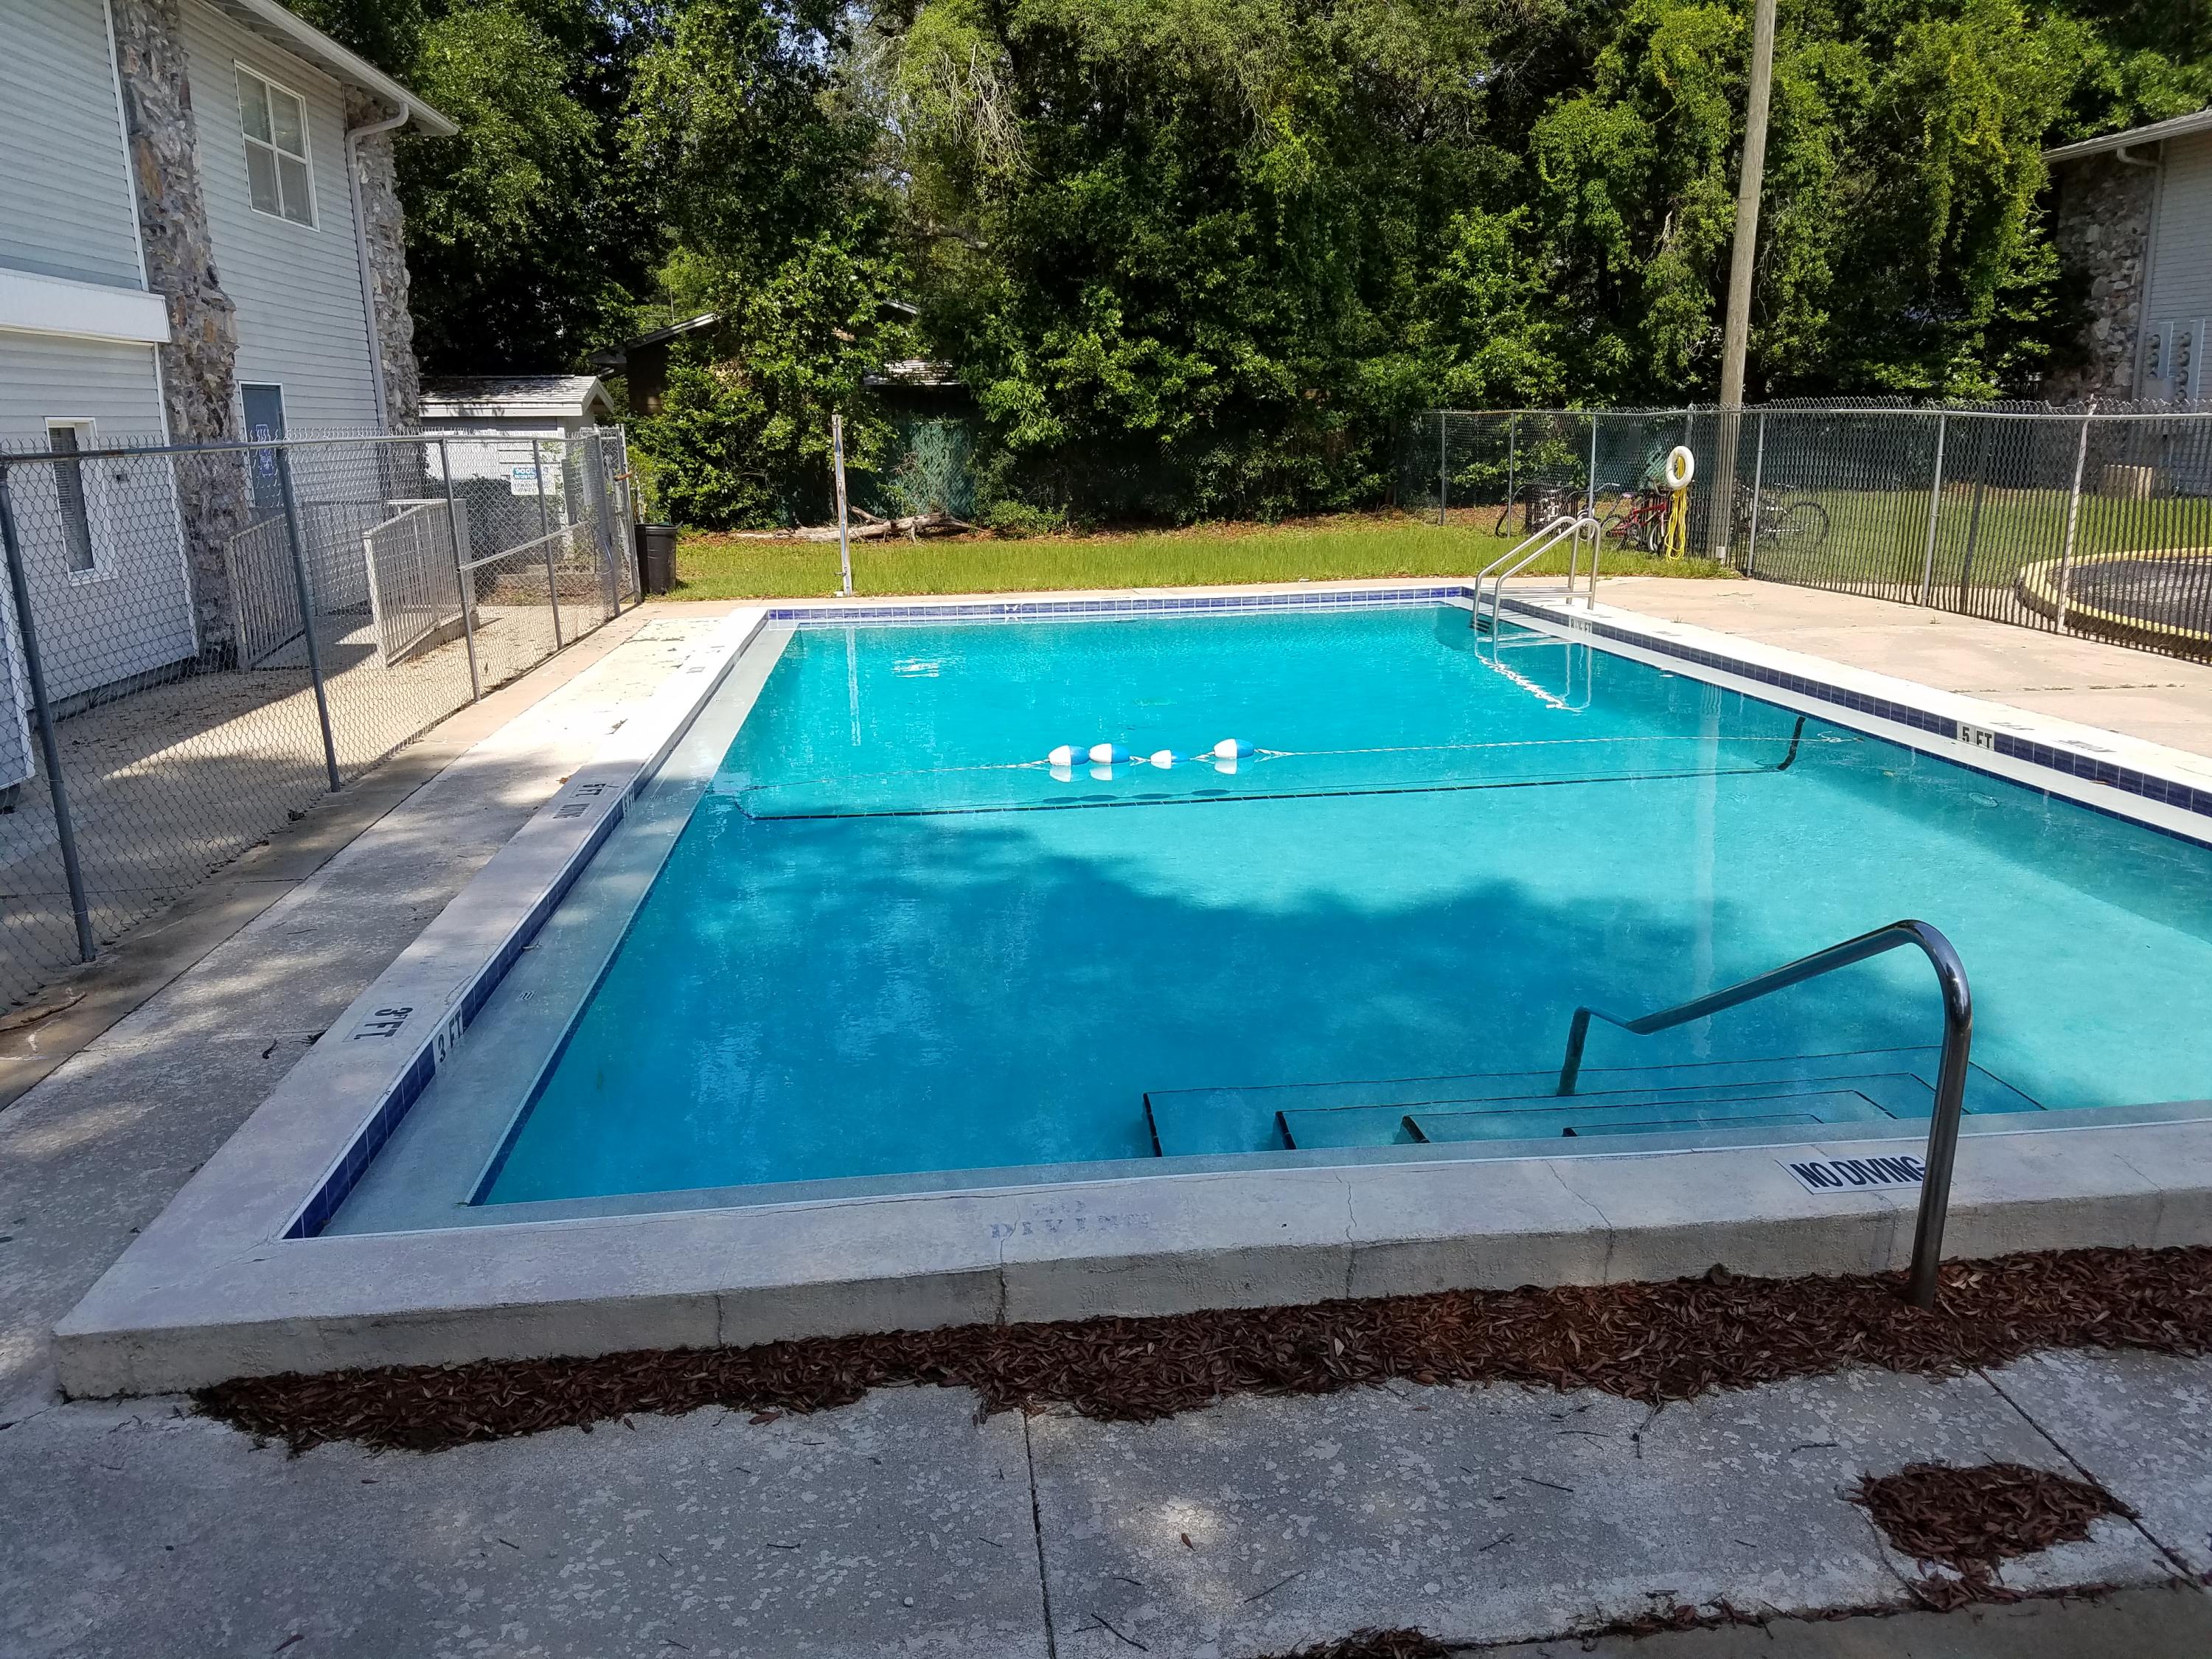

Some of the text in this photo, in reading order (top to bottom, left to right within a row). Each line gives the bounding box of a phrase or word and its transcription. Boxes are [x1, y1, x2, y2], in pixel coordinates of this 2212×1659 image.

[1962, 726, 1970, 742] 5
[1976, 730, 1992, 749] FT
[375, 1007, 414, 1017] 3
[438, 1009, 462, 1063] 3 FT
[1790, 1155, 1926, 1188] NO DIVING
